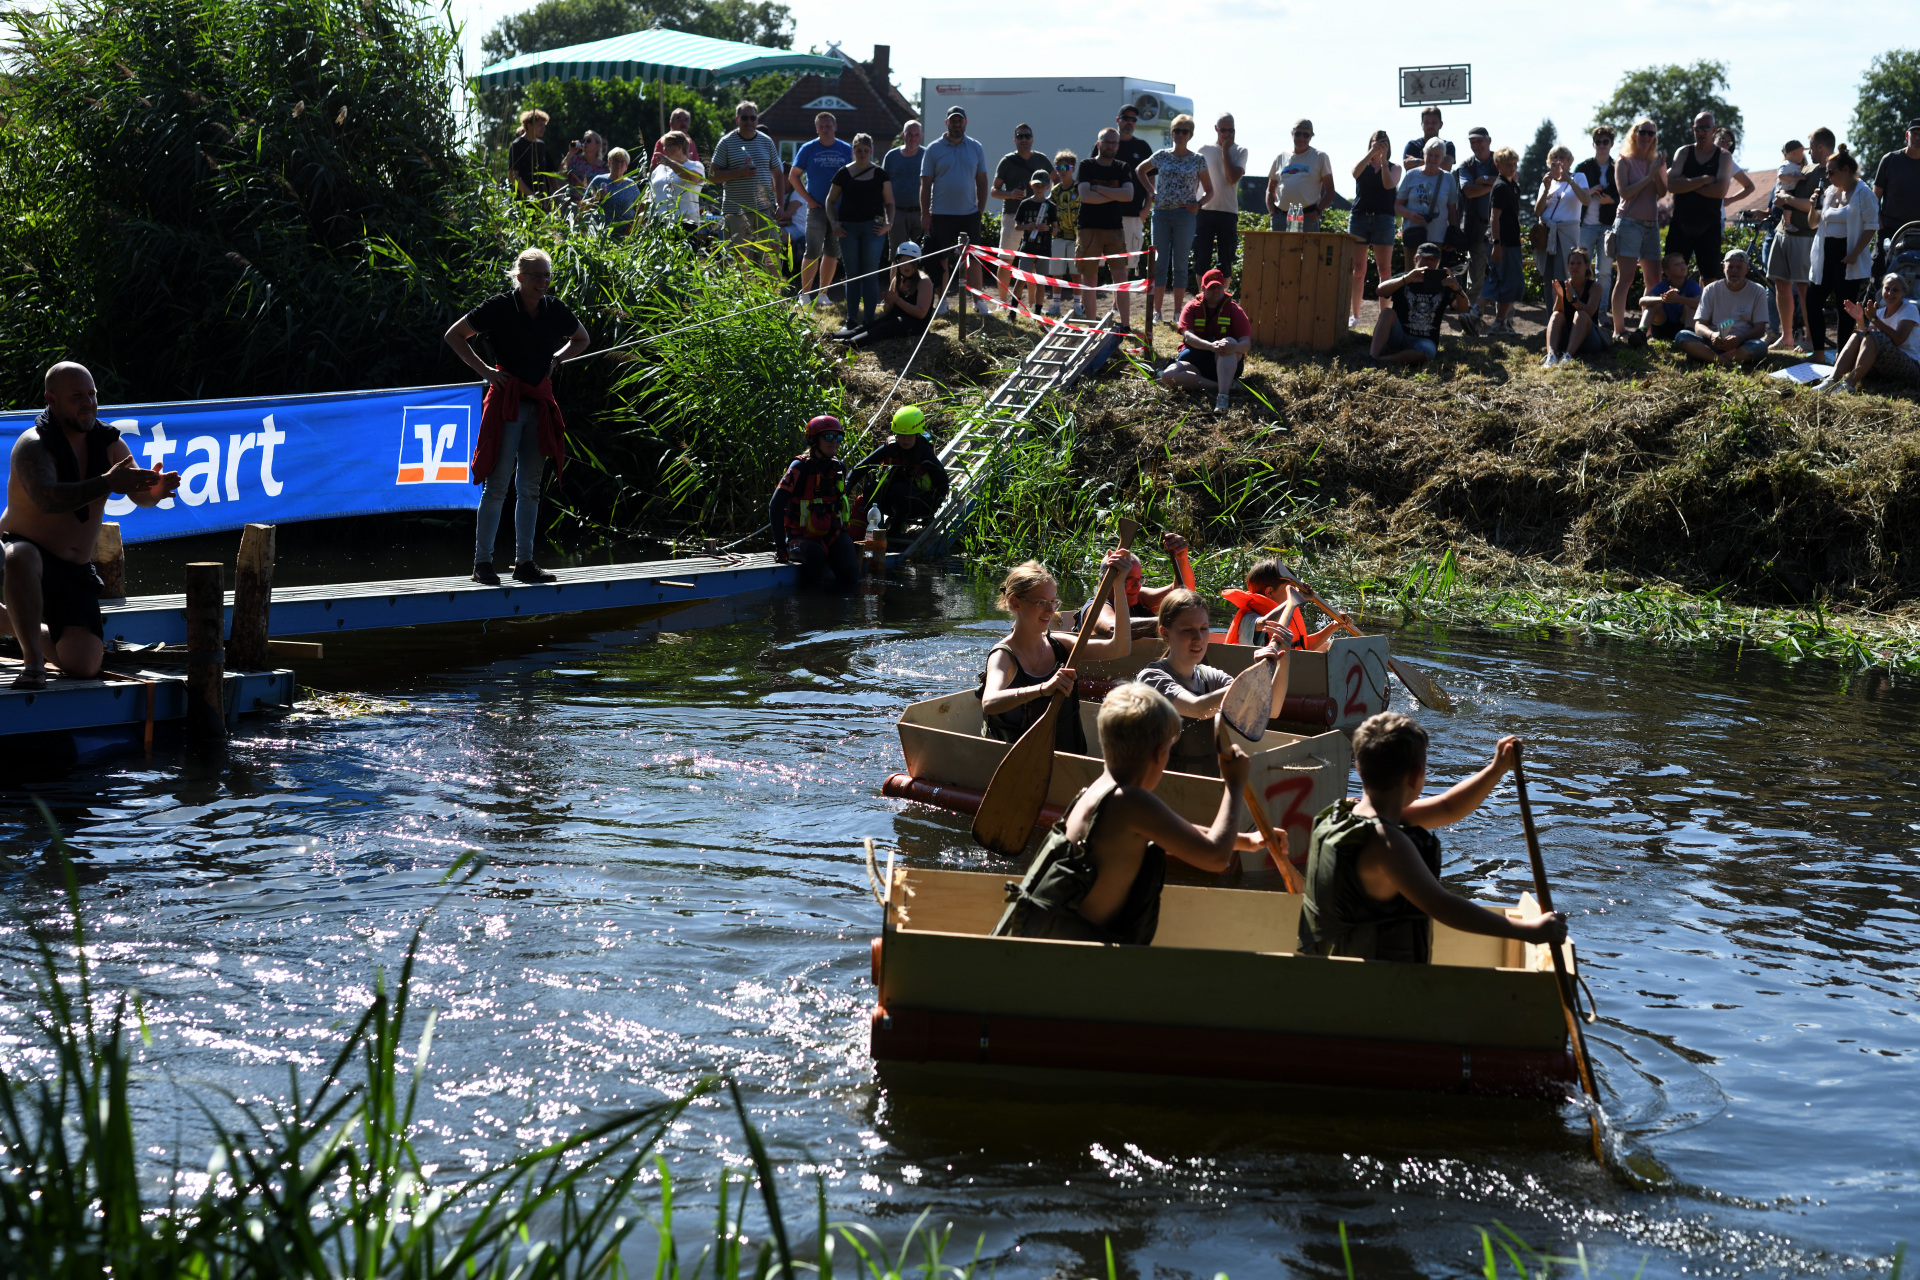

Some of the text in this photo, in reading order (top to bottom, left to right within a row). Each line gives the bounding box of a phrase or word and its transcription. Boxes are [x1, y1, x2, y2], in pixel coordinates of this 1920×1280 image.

[1429, 73, 1459, 94] Café
[104, 413, 286, 516] Start
[1343, 664, 1367, 718] 2
[1264, 775, 1315, 869] 3
